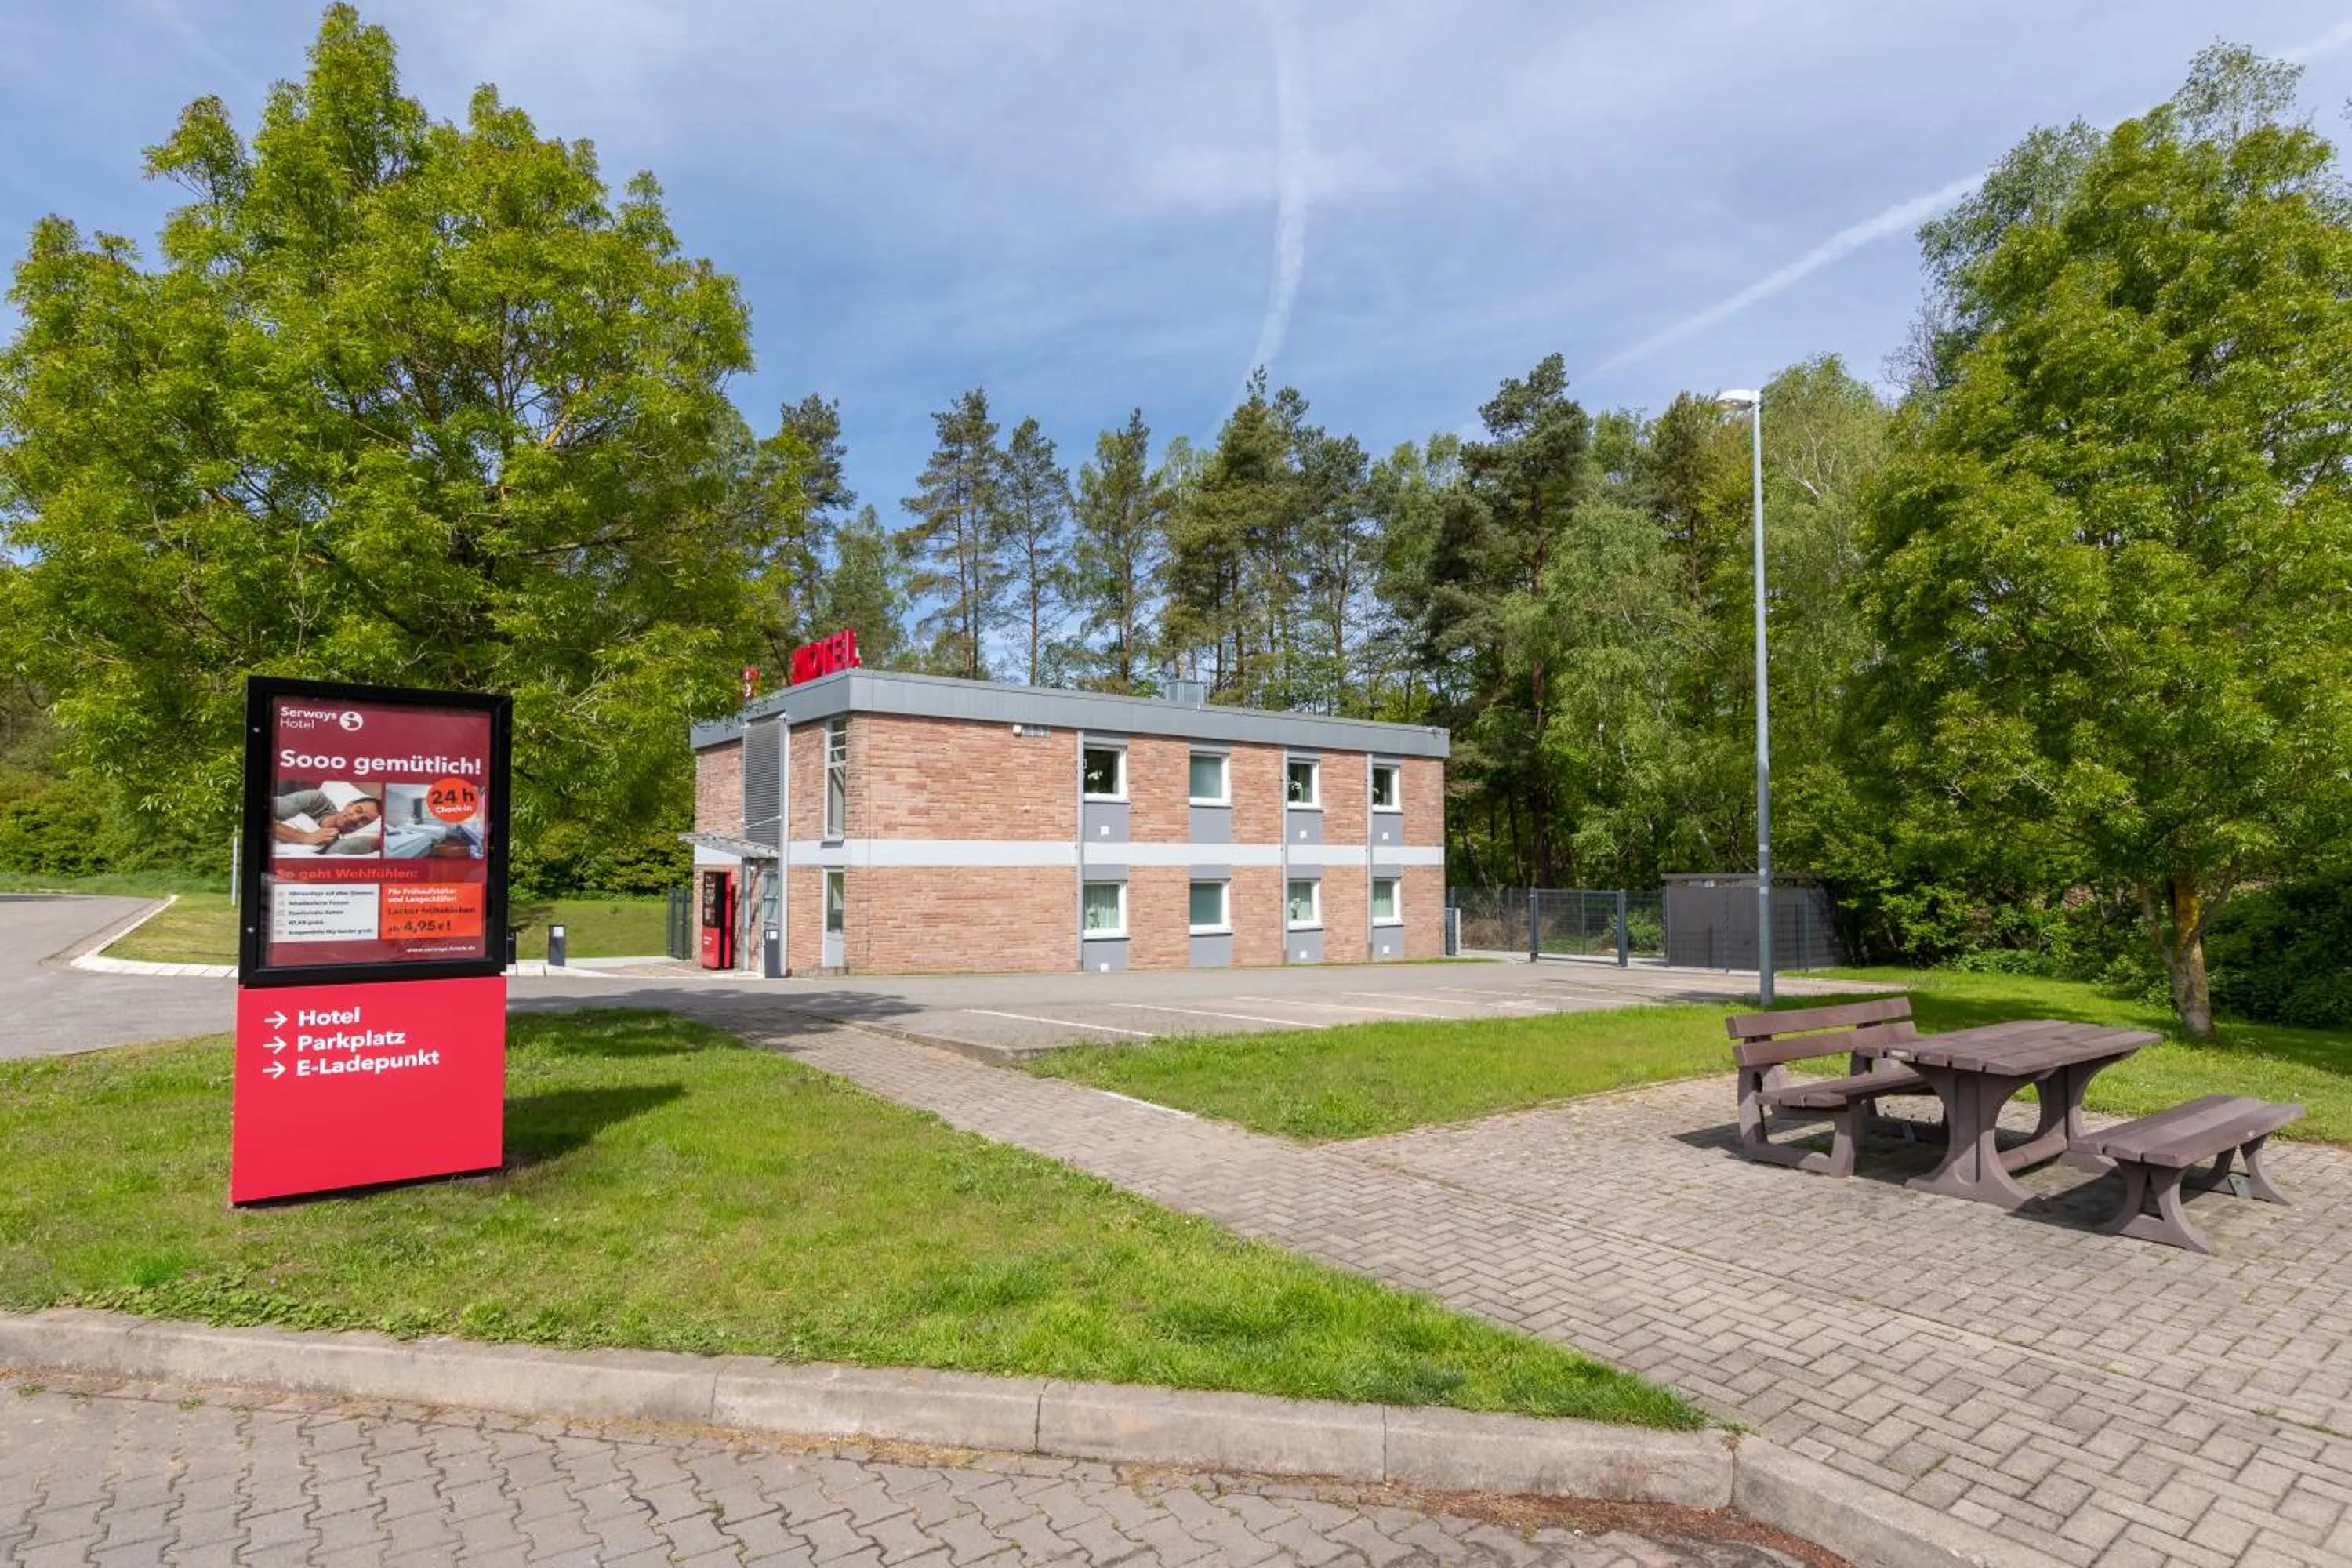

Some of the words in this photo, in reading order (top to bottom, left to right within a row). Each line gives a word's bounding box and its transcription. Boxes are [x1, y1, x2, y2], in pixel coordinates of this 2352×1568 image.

[280, 706, 337, 722] Serways
[280, 718, 314, 729] Hotel
[280, 749, 347, 770] Sooo
[354, 755, 481, 775] gemütlich!
[432, 789, 456, 804] 24
[462, 789, 474, 802] h
[276, 868, 294, 879] So
[299, 868, 332, 880] geht
[403, 920, 436, 934] 4,95
[297, 1006, 361, 1027] Hotel
[296, 1029, 406, 1052] Parkplatz
[296, 1049, 440, 1076] E-Ladepunkt
